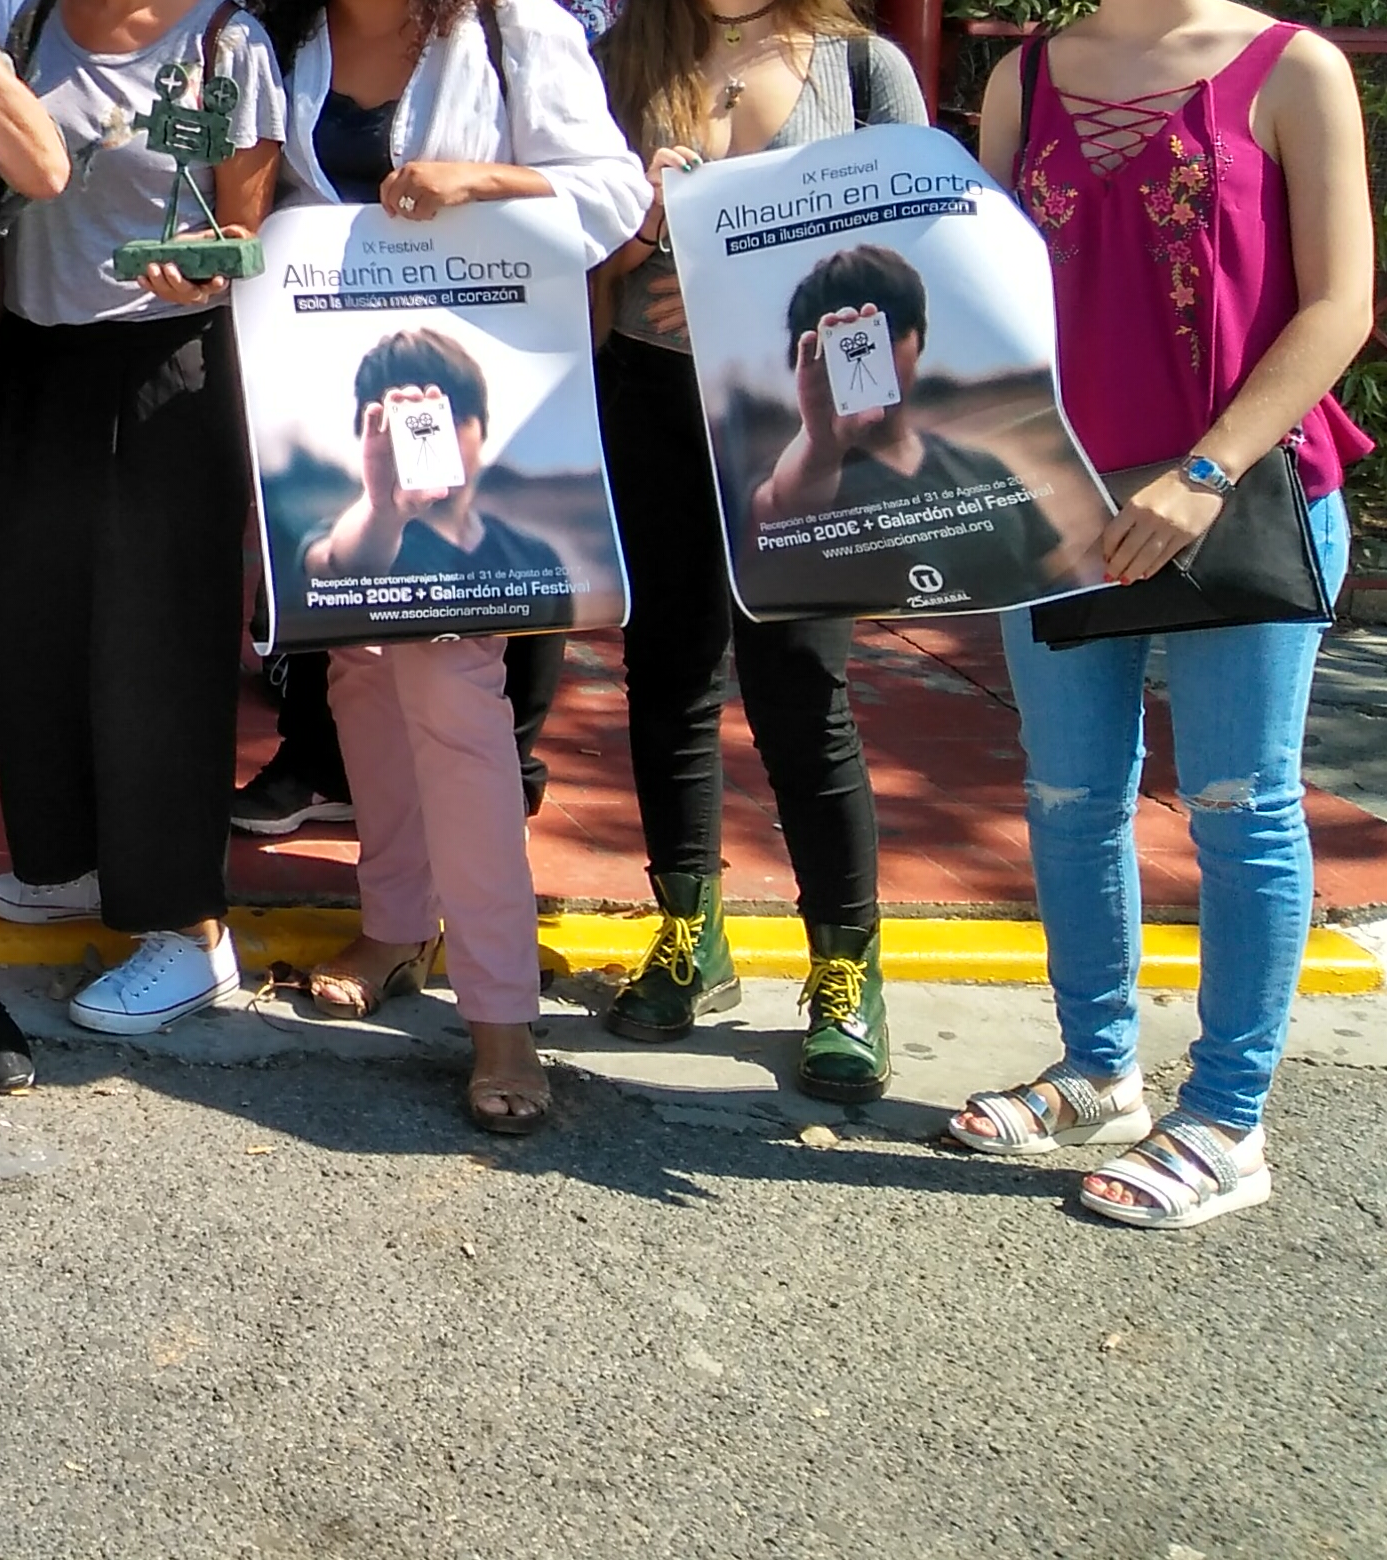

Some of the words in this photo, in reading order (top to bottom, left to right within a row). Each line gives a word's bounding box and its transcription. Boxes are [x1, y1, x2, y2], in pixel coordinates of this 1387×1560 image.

[802, 171, 817, 185] IX
[821, 159, 878, 182] Festival
[715, 191, 832, 234] Alhaurín
[843, 183, 879, 206] en
[890, 172, 983, 196] Corto
[730, 236, 760, 252] solo
[763, 232, 776, 245] la
[779, 222, 826, 241] ilusión
[829, 211, 879, 231] mueve
[883, 205, 897, 220] el
[362, 241, 376, 254] IX
[379, 238, 434, 254] Festival
[283, 261, 394, 288] Alhaurín
[402, 264, 437, 284] en
[445, 256, 532, 282] Corto
[297, 297, 327, 310] solo
[441, 290, 454, 304] el
[458, 288, 518, 303] corazón
[924, 491, 939, 502] 31
[941, 489, 954, 499] de
[956, 484, 991, 497] Agosto
[757, 530, 811, 551] Premio
[814, 520, 860, 541] 200€
[863, 519, 874, 531] +
[878, 506, 953, 530] Galardón
[957, 498, 983, 515] del
[984, 483, 1054, 510] Festival
[822, 520, 994, 559] www.asociacionarrabal.org
[311, 577, 358, 589] Recepción
[360, 576, 372, 586] de
[479, 570, 492, 580] 31
[495, 569, 506, 579] de
[508, 569, 540, 580] Agosto
[542, 568, 553, 577] de
[307, 590, 363, 608] Premio
[366, 587, 412, 604] 200€
[415, 588, 426, 600] +
[430, 584, 500, 601] Galardón
[504, 582, 527, 596] del
[531, 579, 590, 595] Festival
[369, 603, 529, 621] www.asociacionarrabal.org
